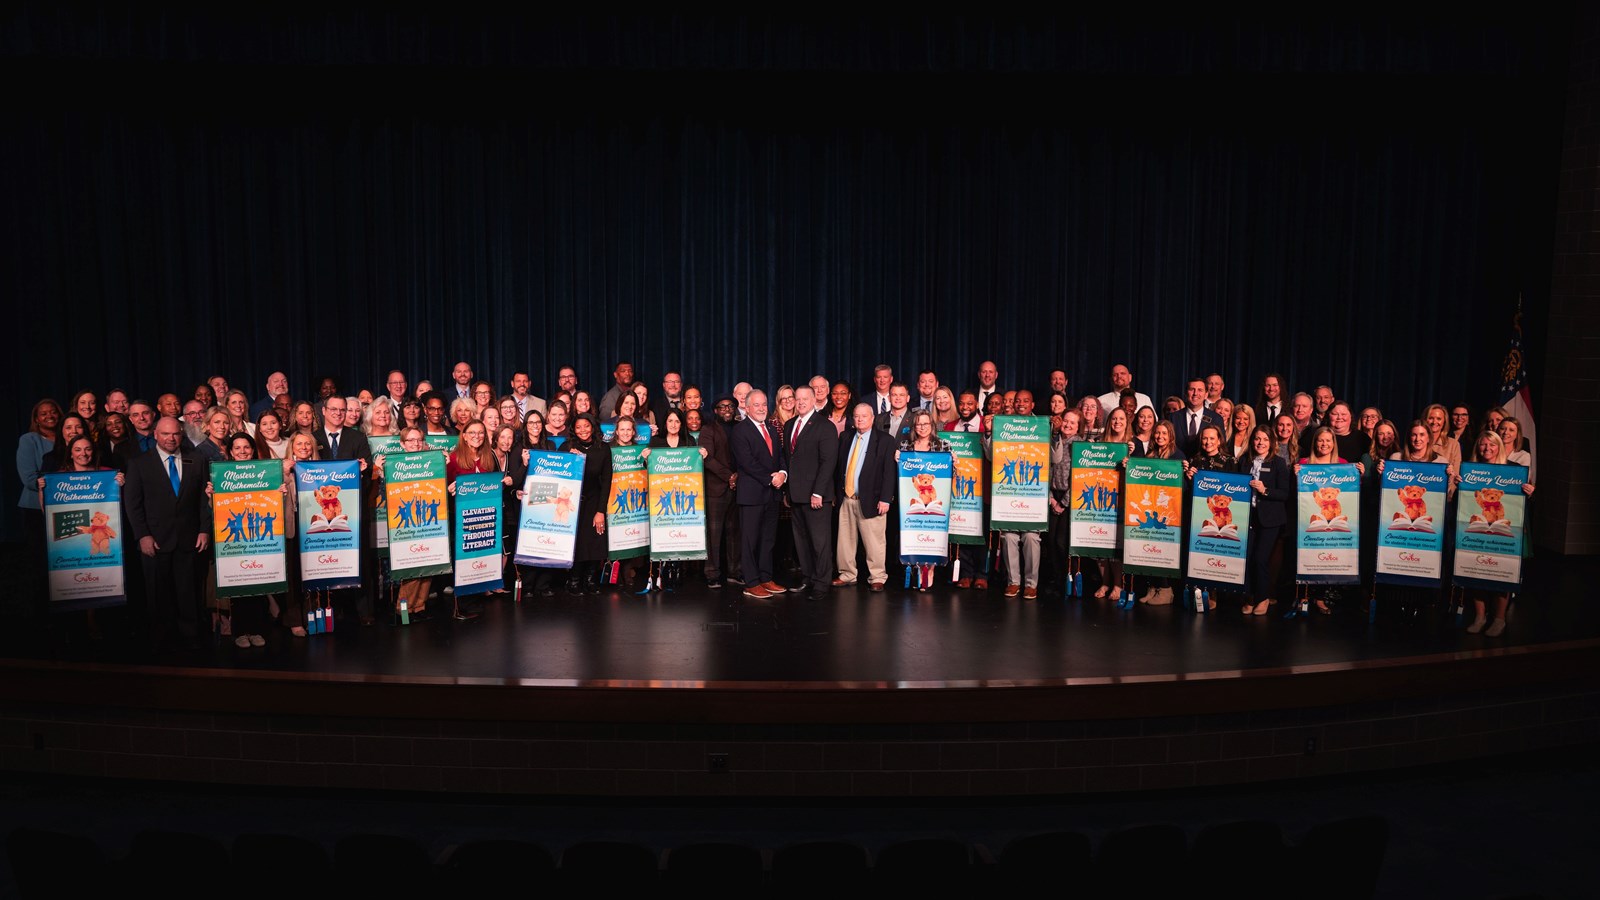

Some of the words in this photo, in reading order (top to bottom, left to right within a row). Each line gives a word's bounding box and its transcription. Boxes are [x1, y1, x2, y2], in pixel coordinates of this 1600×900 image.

[1003, 423, 1028, 432] Masters
[1000, 432, 1039, 440] Mathematics
[1082, 450, 1106, 458] Masters
[537, 458, 562, 467] Masters
[657, 456, 682, 464] Masters
[1079, 458, 1116, 466] Mathematics
[395, 462, 421, 471] Masters
[534, 466, 572, 476] Mathematics
[902, 462, 924, 471] Literacy
[926, 462, 948, 471] Leaders
[224, 471, 256, 480] Masters
[257, 470, 266, 479] of
[300, 473, 328, 483] Literacy
[330, 472, 356, 482] Leaders
[393, 471, 434, 480] Mathematics
[1129, 469, 1153, 479] Literacy
[1155, 470, 1178, 480] Leaders
[1302, 475, 1328, 484] Literacy
[1330, 474, 1356, 484] Leaders
[1387, 471, 1414, 482] Literacy
[1416, 473, 1443, 483] Leaders
[1464, 473, 1492, 485] Literacy
[1495, 476, 1522, 486] Leaders
[57, 482, 90, 492] Masters
[93, 481, 102, 491] of
[221, 481, 269, 491] Mathematics
[458, 486, 478, 495] Literacy
[480, 484, 499, 493] Leaders
[1198, 480, 1222, 492] Literacy
[1224, 483, 1248, 493] Leaders
[54, 492, 104, 502] Mathematics
[462, 507, 495, 516] ELEVATING
[463, 530, 494, 540] THROUGH
[462, 539, 494, 549] LITERACY
